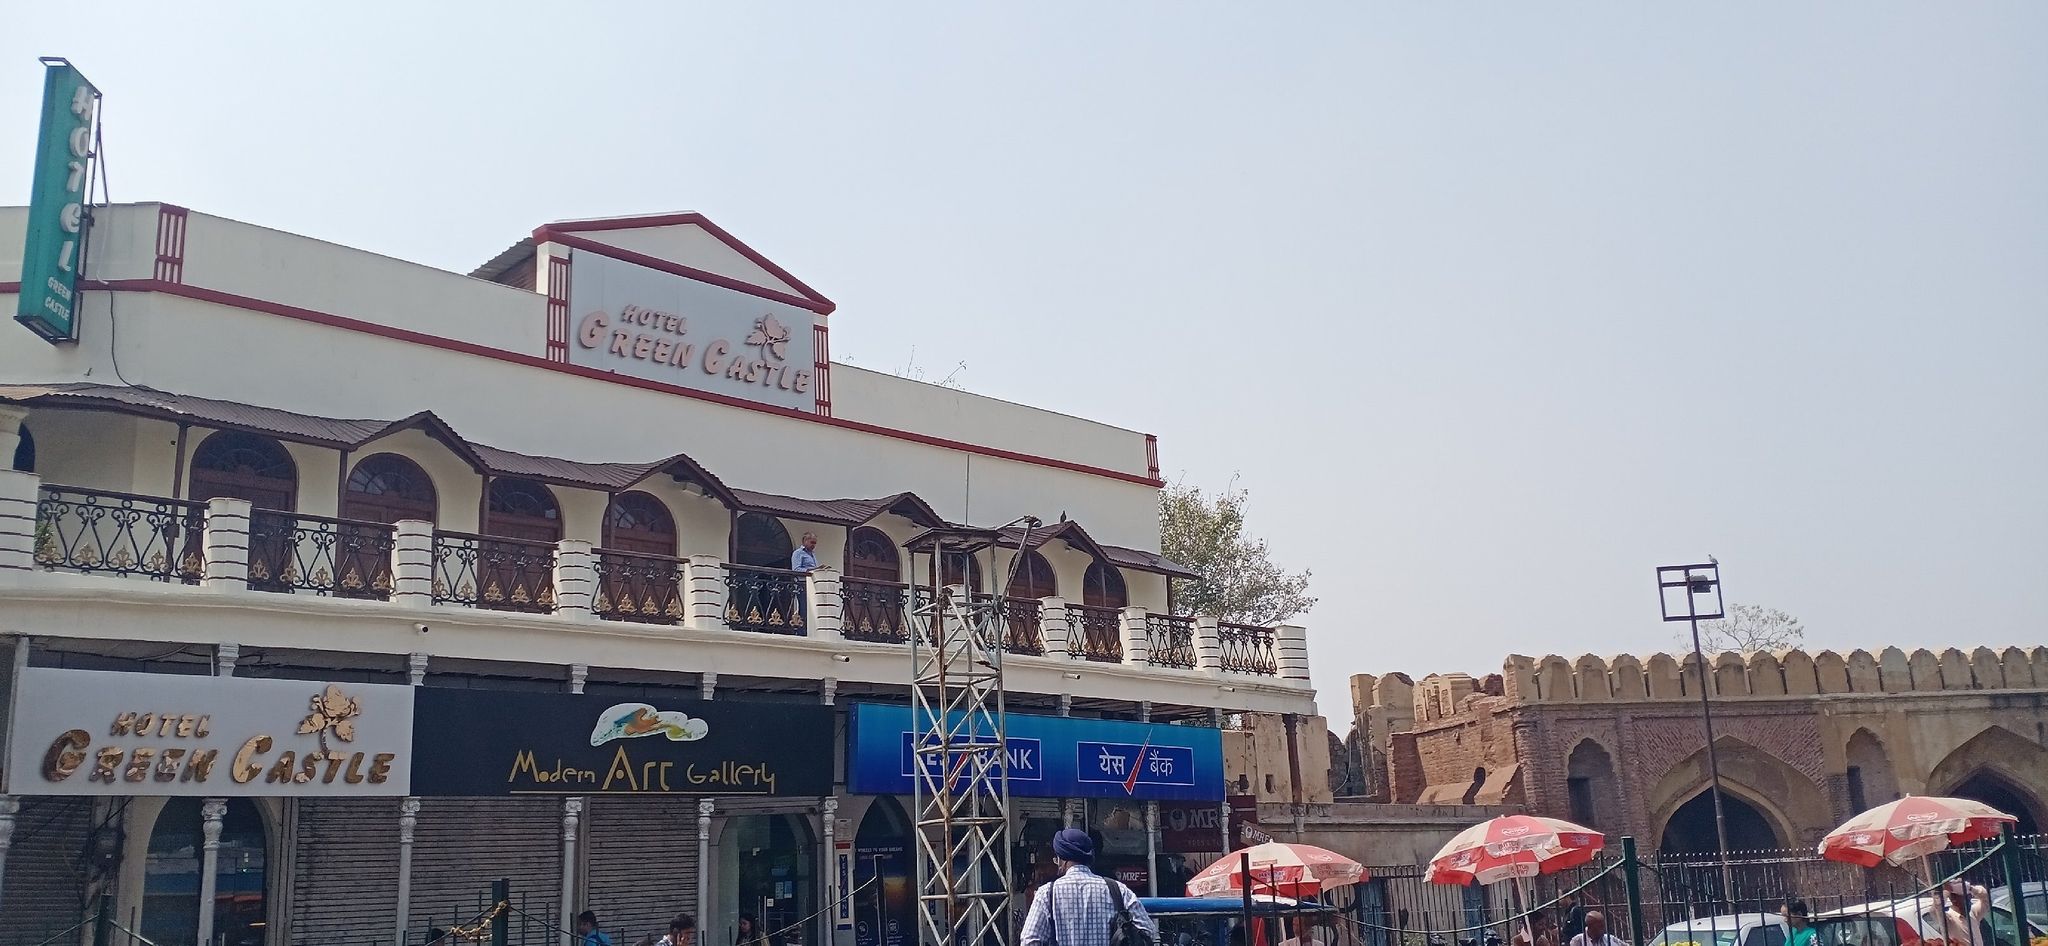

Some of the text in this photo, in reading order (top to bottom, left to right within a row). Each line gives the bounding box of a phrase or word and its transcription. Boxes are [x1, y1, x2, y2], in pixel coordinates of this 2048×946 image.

[44, 296, 70, 321] CASTLE
[622, 304, 688, 335] HOTEL
[579, 310, 811, 393] GREEN CASTLE
[111, 711, 210, 738] HOTEL
[43, 729, 395, 784] GREEN CASTLE
[508, 744, 776, 795] Modern Art Gallery
[1098, 746, 1174, 777] येस बैंक
[1188, 808, 1225, 829] MR
[1252, 829, 1270, 843] MRF
[1122, 871, 1140, 881] MRF
